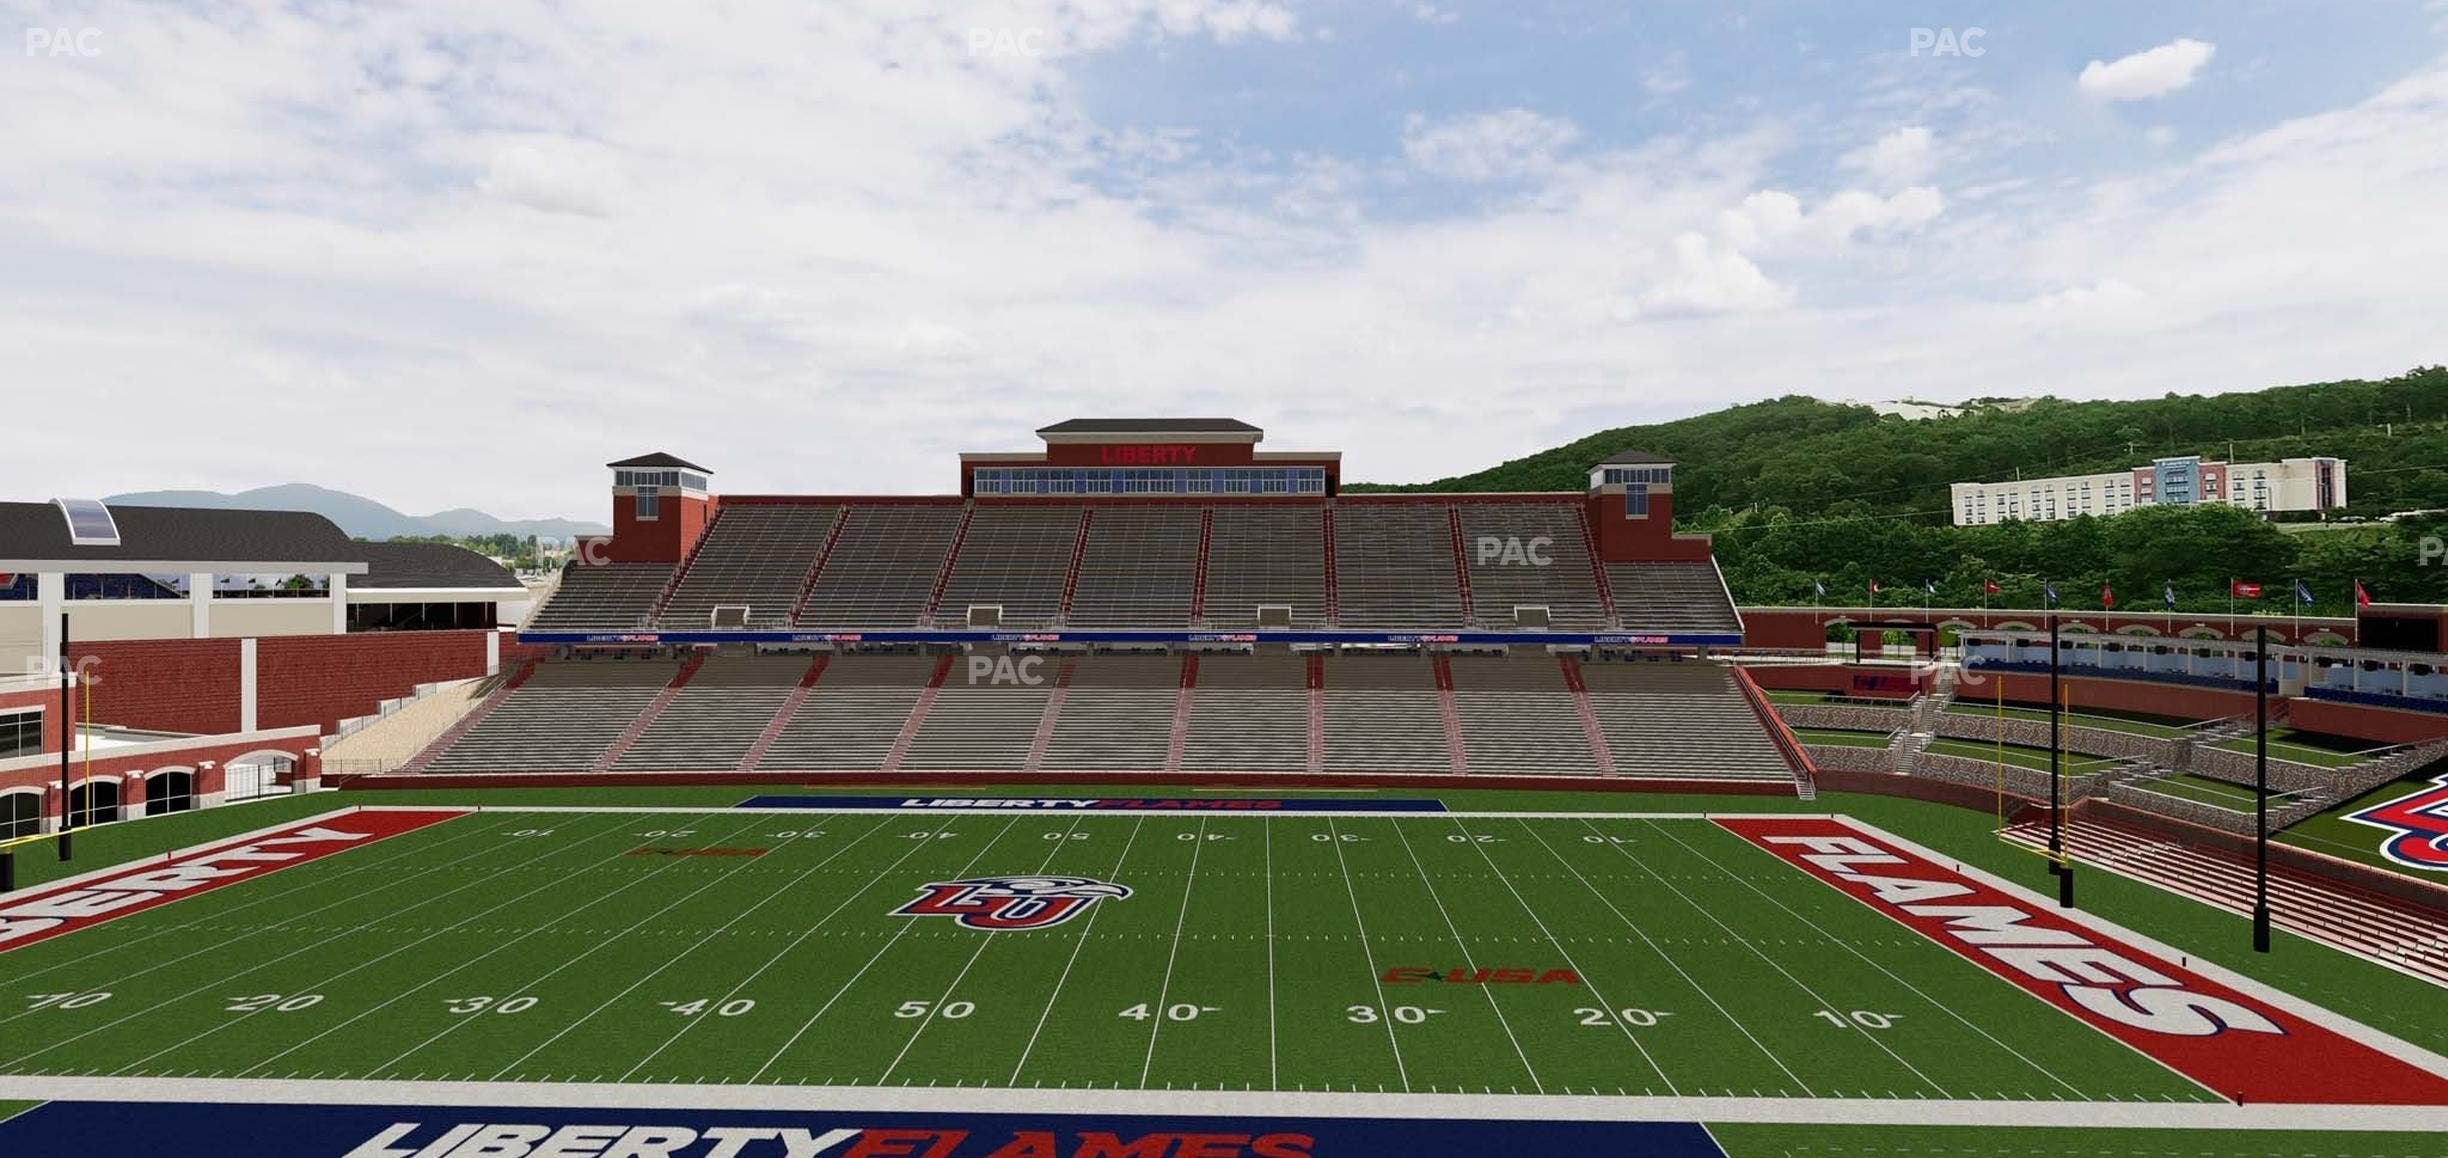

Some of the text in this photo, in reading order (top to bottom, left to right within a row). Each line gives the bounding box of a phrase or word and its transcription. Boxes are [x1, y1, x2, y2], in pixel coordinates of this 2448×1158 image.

[1101, 445, 1197, 464] LIBERTY
[901, 799, 1101, 808] LIBERTY
[1043, 832, 1091, 841] 50
[1761, 835, 2288, 1037] FLAMES
[28, 992, 112, 1009] 10
[225, 994, 325, 1011] 20
[449, 996, 539, 1014] 30
[669, 999, 756, 1016] 40
[894, 1001, 976, 1019] 50
[1118, 1003, 1200, 1021] 40
[1346, 1005, 1427, 1024] 30
[1573, 1008, 1658, 1026] 20
[1812, 1010, 1893, 1030] 10
[342, 1122, 1315, 1158] LIBERTY FLAMES
